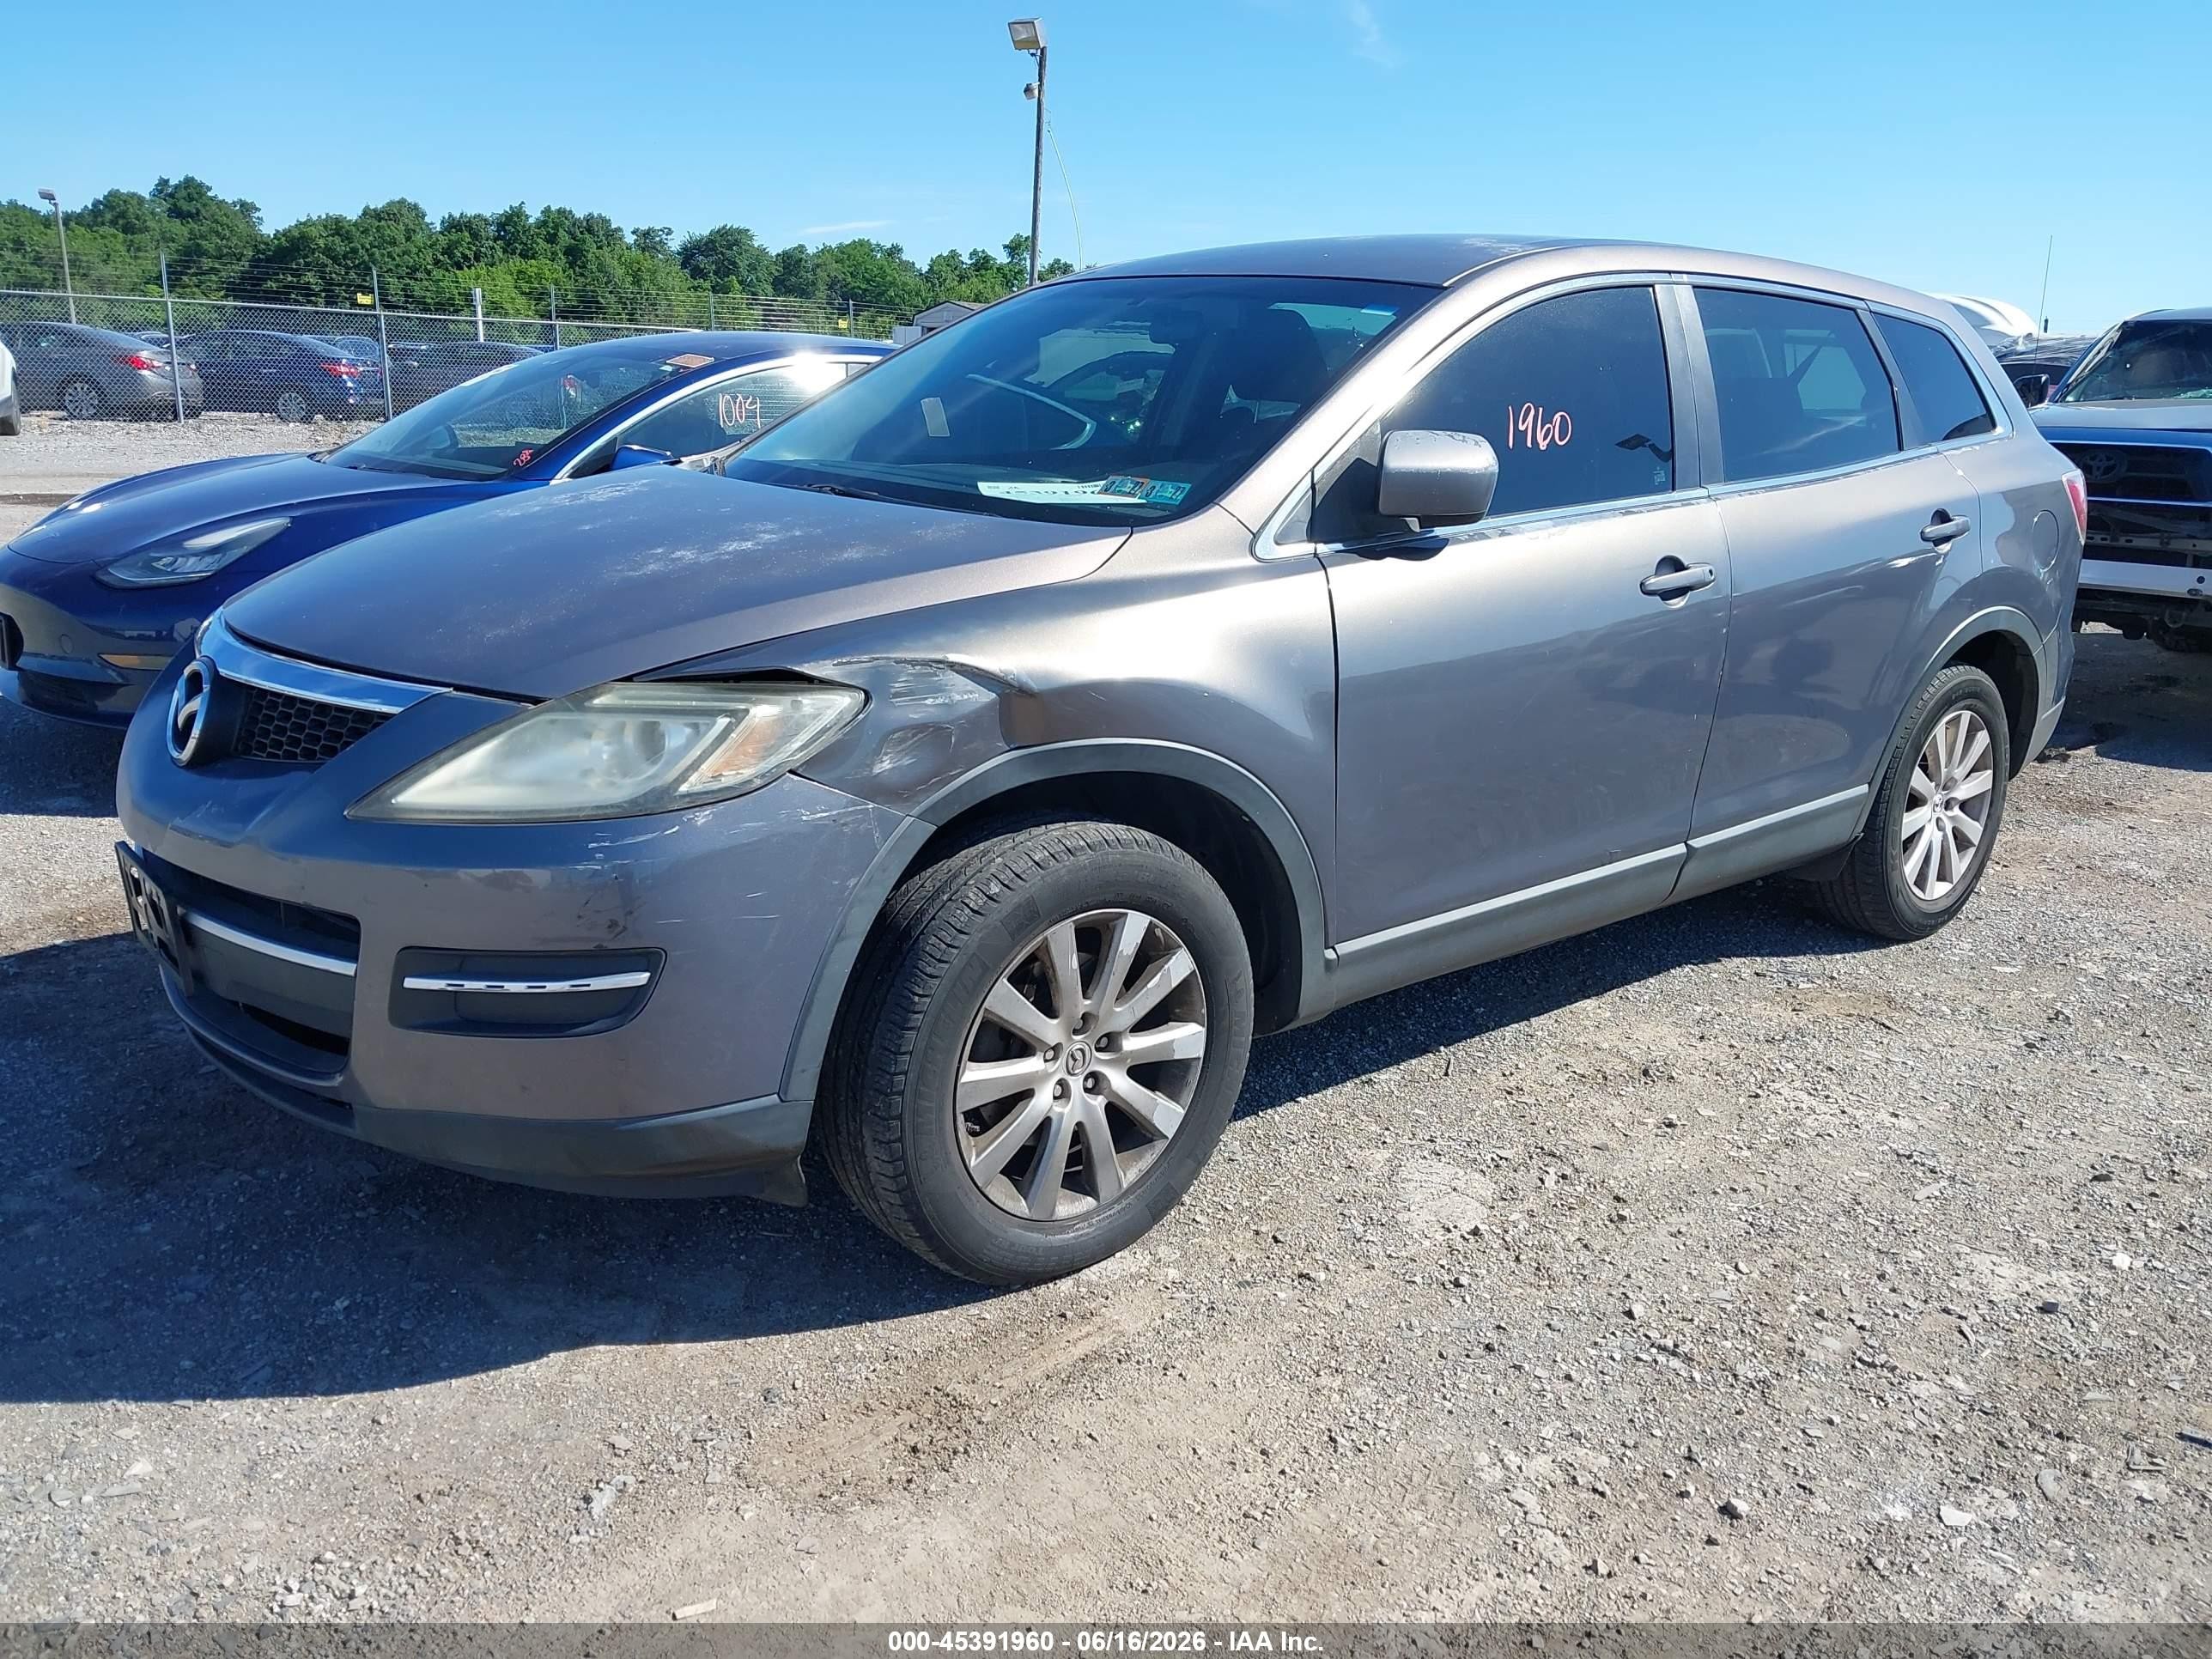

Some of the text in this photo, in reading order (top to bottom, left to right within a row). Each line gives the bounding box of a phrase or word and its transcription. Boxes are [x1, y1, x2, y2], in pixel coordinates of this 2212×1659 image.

[719, 392, 761, 428] 1004
[1508, 402, 1571, 450] 1960
[1104, 480, 1116, 492] 3
[1145, 485, 1156, 497] 3
